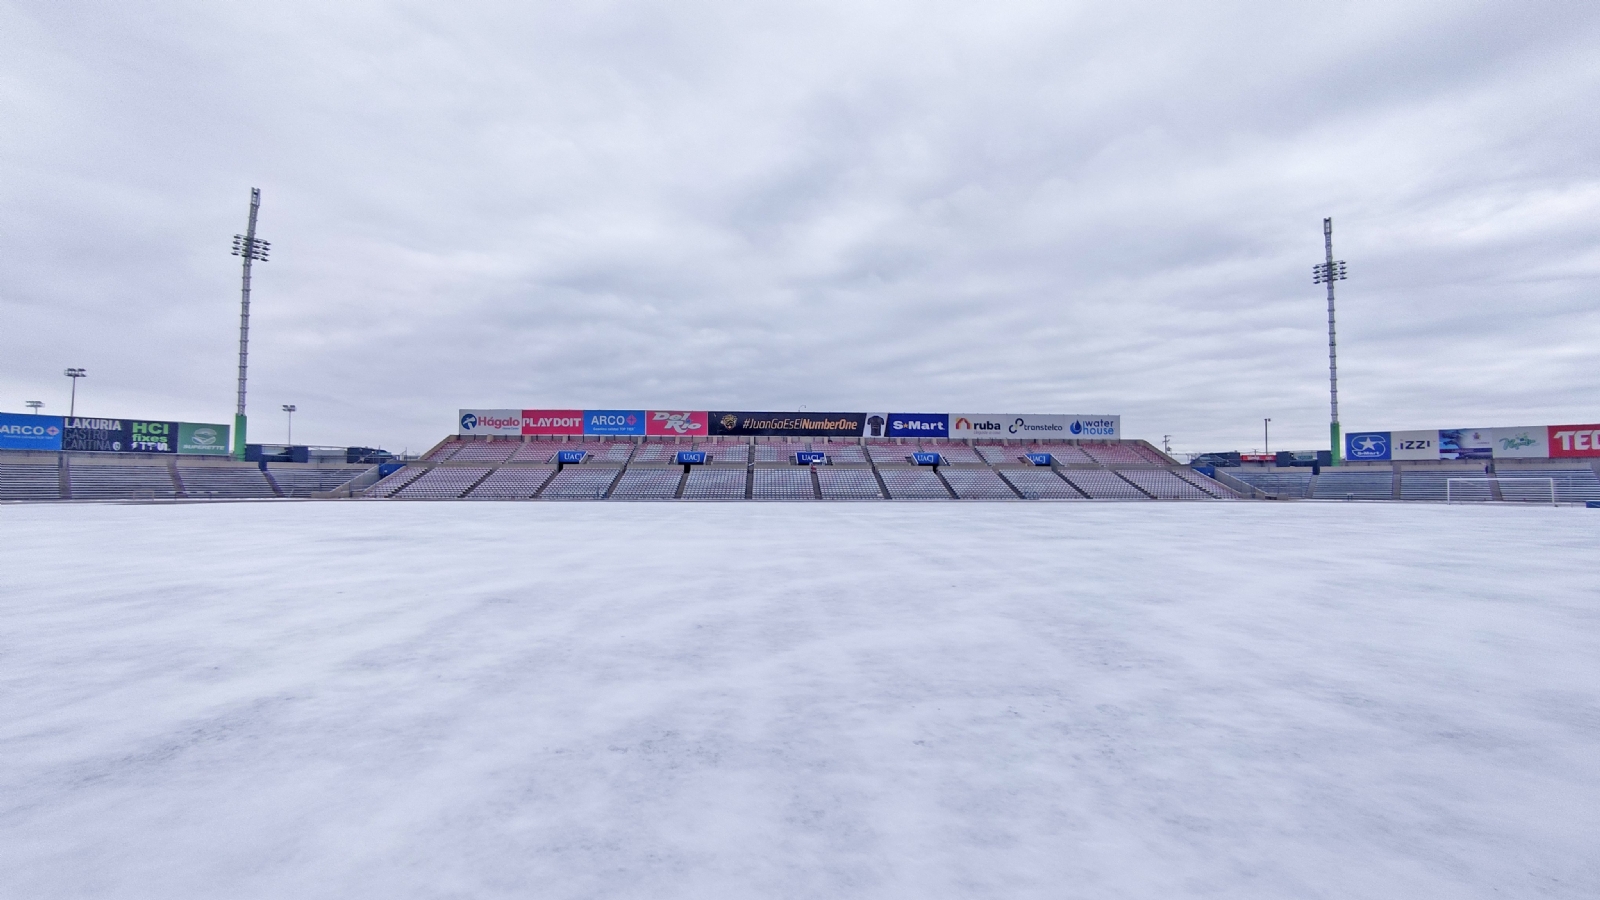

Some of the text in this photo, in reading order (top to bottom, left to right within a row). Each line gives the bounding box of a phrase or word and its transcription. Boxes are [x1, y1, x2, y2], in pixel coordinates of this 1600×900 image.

[591, 415, 625, 425] ARCO
[652, 412, 691, 421] Del
[64, 417, 121, 430] LAKURIA
[478, 416, 520, 429] Hágalo
[523, 417, 581, 427] PLAYDOIT
[664, 419, 702, 433] Rio
[974, 421, 1001, 430] ruba
[1024, 423, 1063, 431] transtelco
[1085, 419, 1114, 427] water
[0, 425, 44, 435] ARCO
[132, 422, 169, 434] HCI
[1083, 421, 1114, 435] house
[64, 429, 109, 440] GASTRO
[132, 433, 168, 443] fixes
[63, 438, 111, 450] CANTINA
[683, 454, 700, 462] UACJ
[917, 454, 934, 463] UACJ
